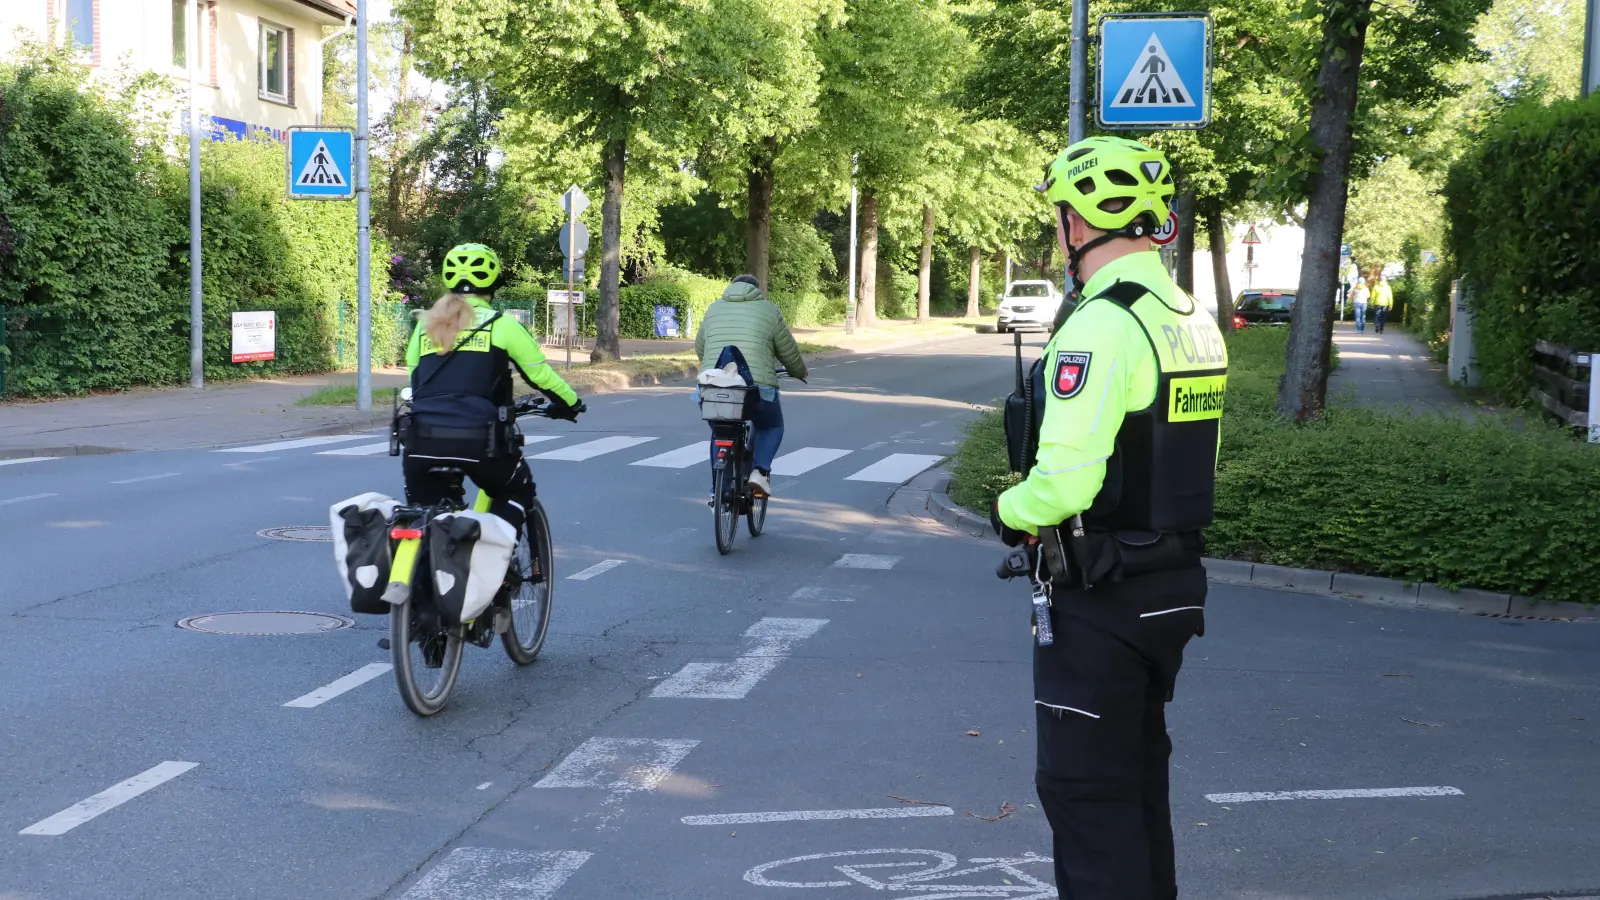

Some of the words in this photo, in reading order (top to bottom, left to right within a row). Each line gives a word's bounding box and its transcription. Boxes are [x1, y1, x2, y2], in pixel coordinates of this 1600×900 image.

[1067, 157, 1099, 180] POLIZEI
[1161, 324, 1226, 364] POLIZEI
[1059, 355, 1087, 364] POLIZEI
